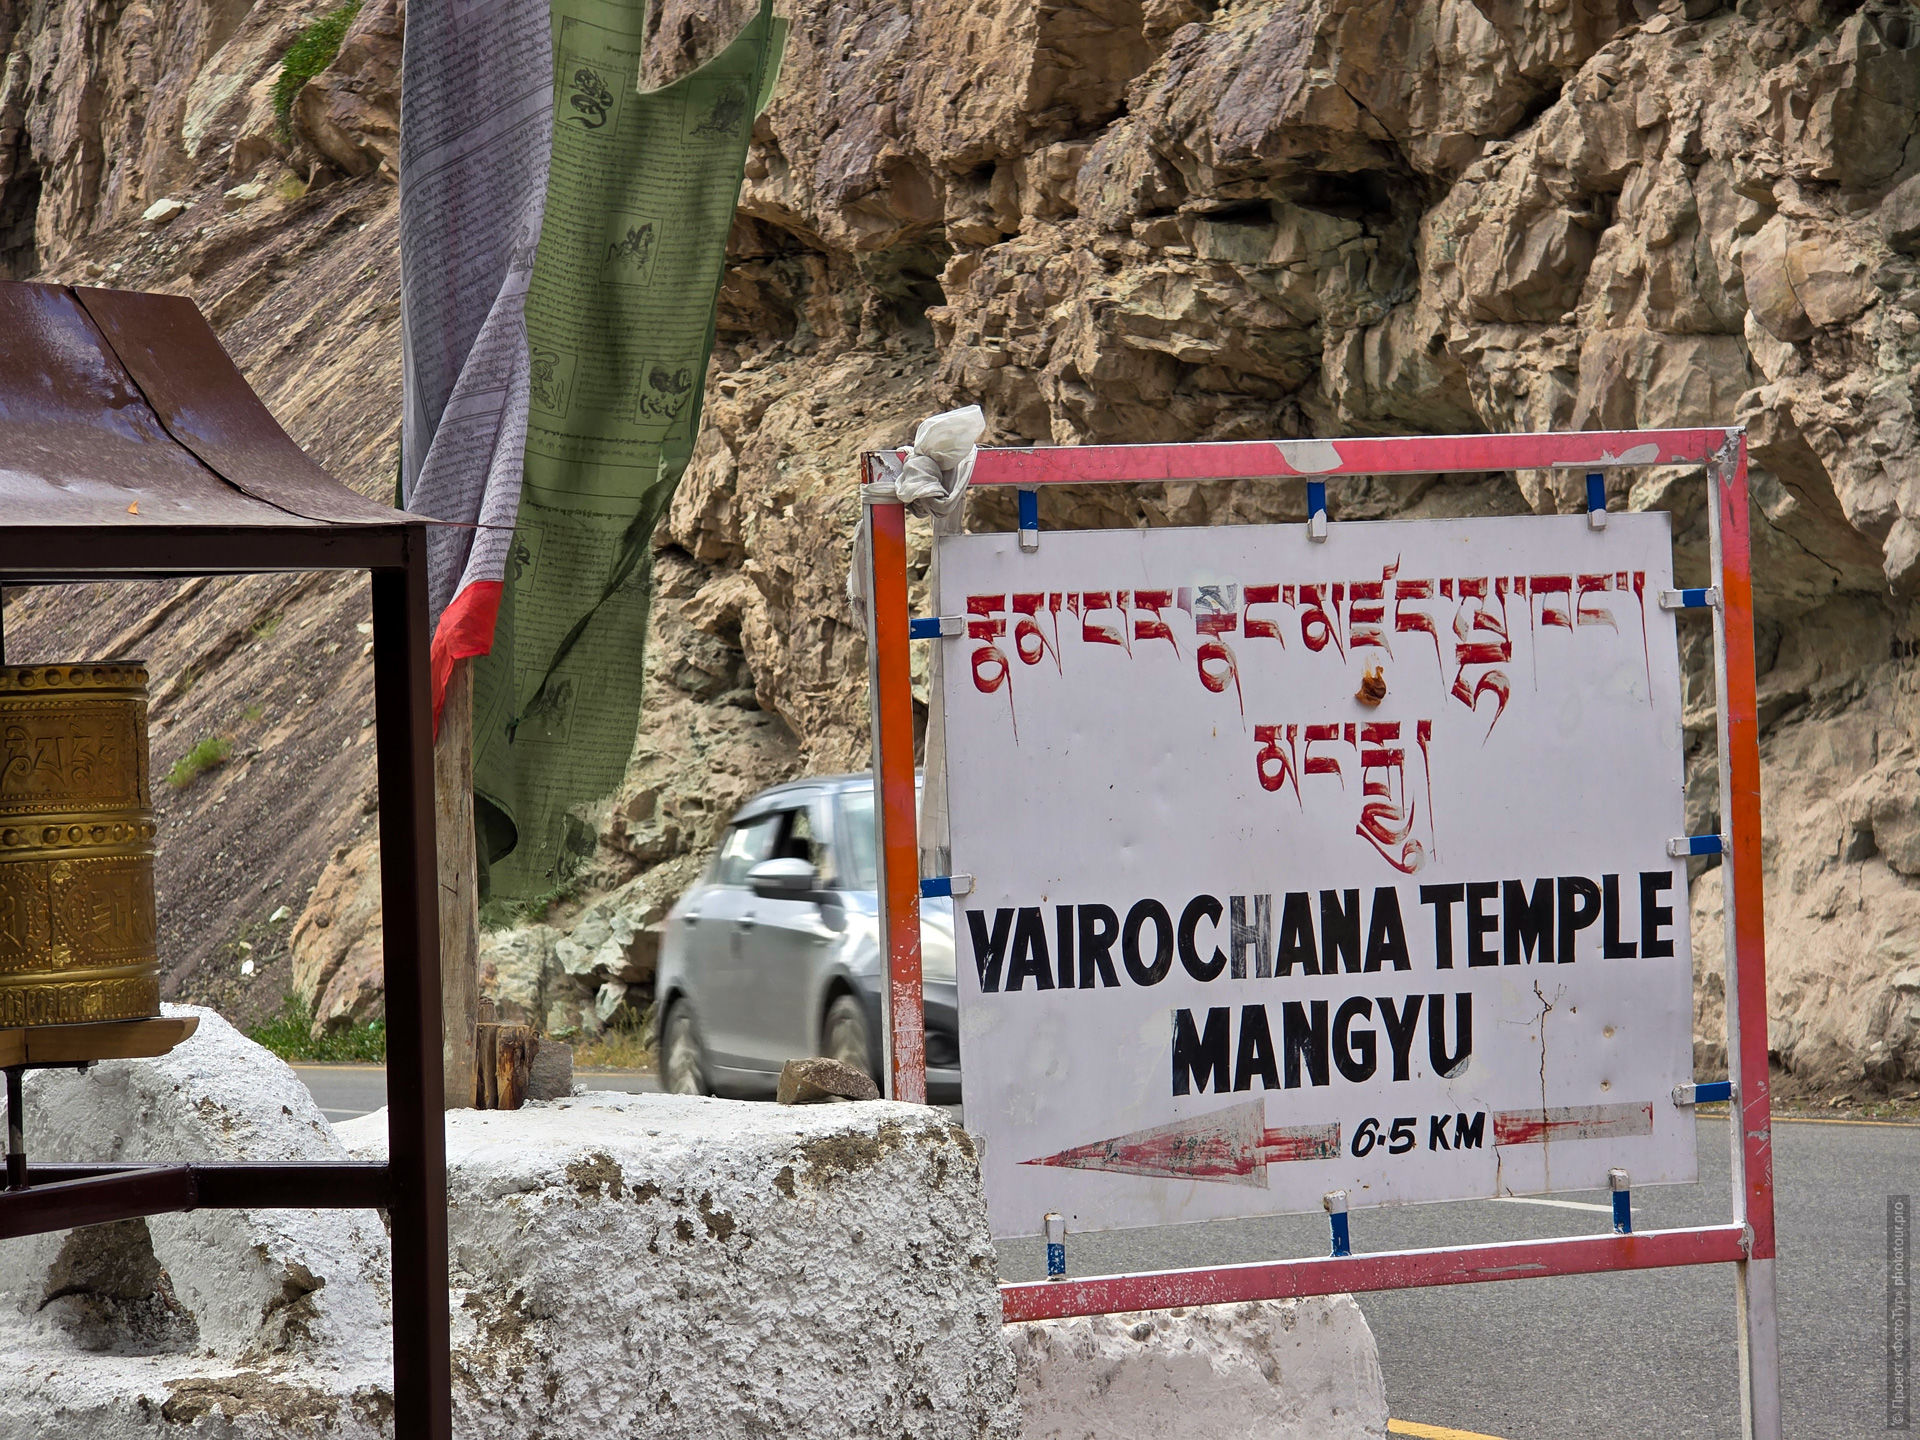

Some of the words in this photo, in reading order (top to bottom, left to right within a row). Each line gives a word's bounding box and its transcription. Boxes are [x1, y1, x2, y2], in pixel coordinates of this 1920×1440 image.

[966, 886, 1411, 993] VAIROCHANA
[1420, 871, 1674, 969] TEMPLE
[1172, 992, 1472, 1097] MANGYU
[1429, 1111, 1486, 1152] KM
